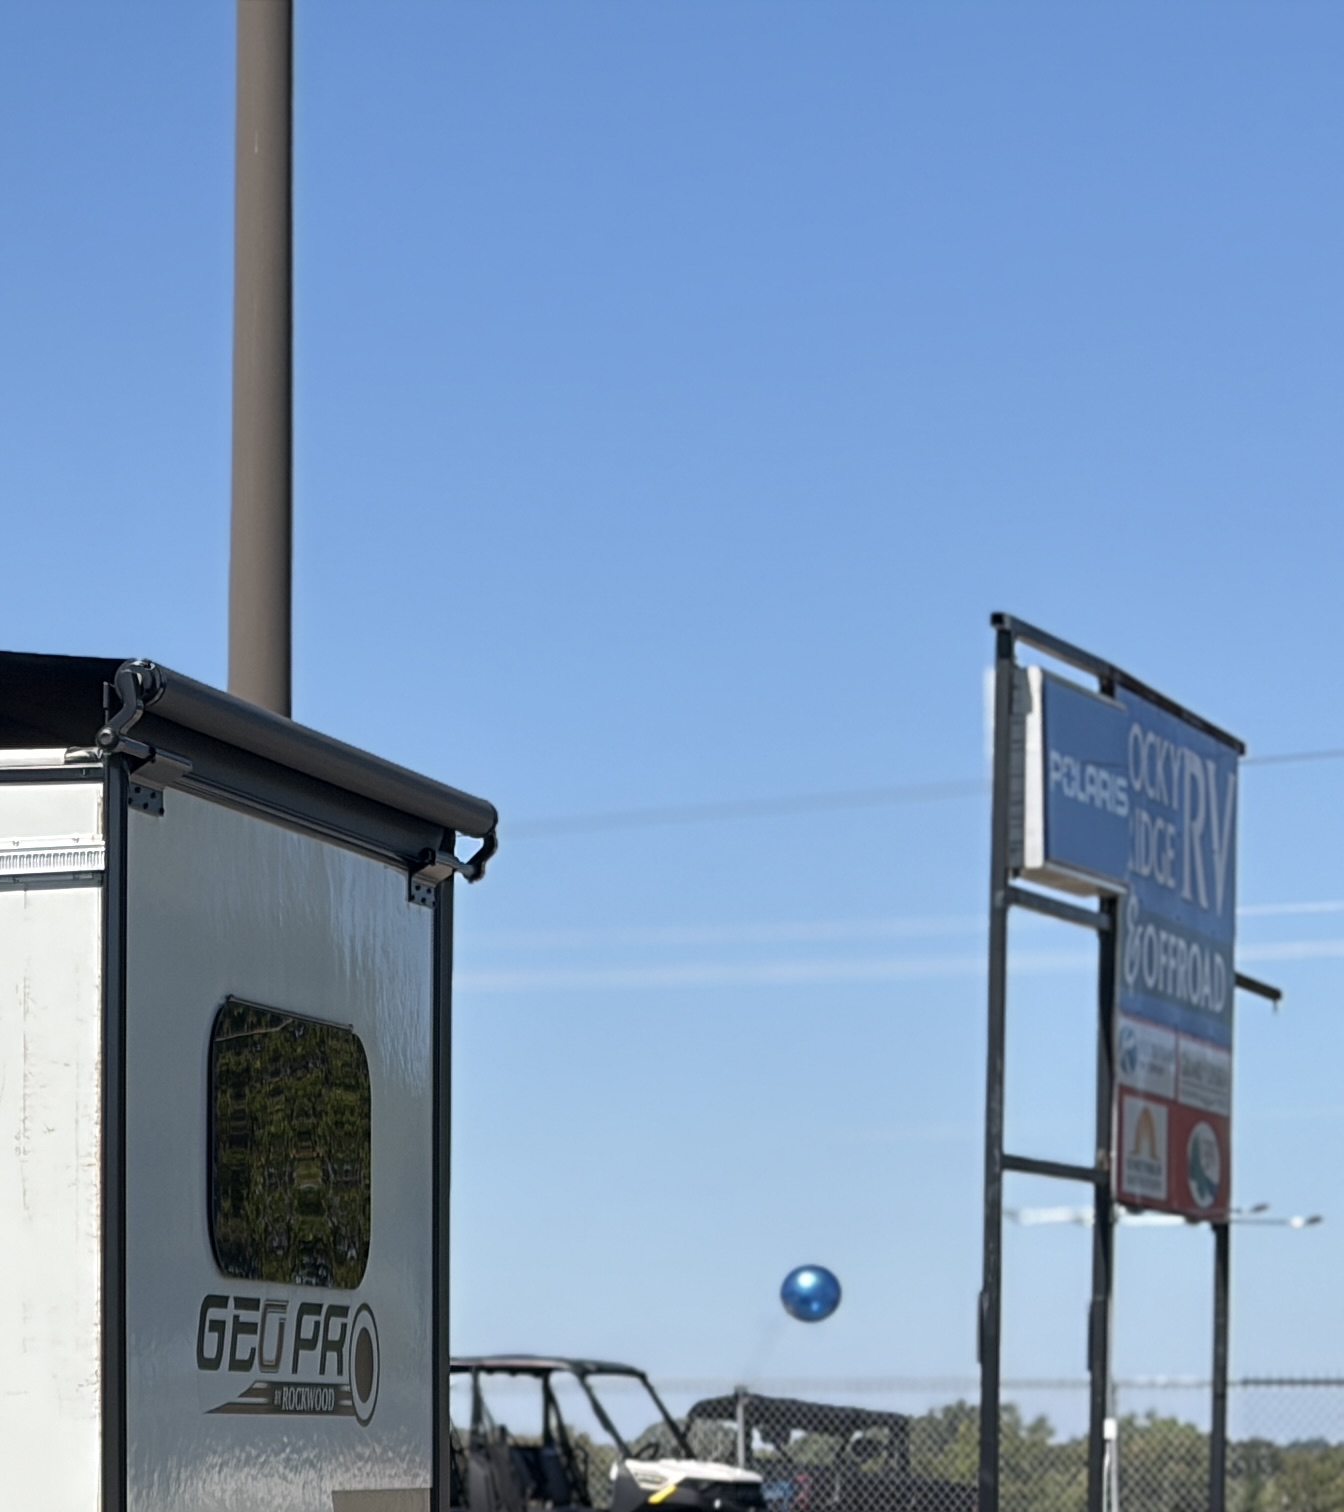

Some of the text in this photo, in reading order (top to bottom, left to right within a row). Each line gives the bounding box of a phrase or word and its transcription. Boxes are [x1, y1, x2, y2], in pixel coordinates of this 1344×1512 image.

[1049, 751, 1129, 818] POLARIS
[1127, 721, 1179, 811] OCKY
[1128, 808, 1177, 889] IDGE
[1180, 745, 1236, 918] RV
[1142, 923, 1227, 1014] OFFROAD
[196, 1293, 289, 1374] GEO
[282, 1386, 335, 1412] ROCKWOOD
